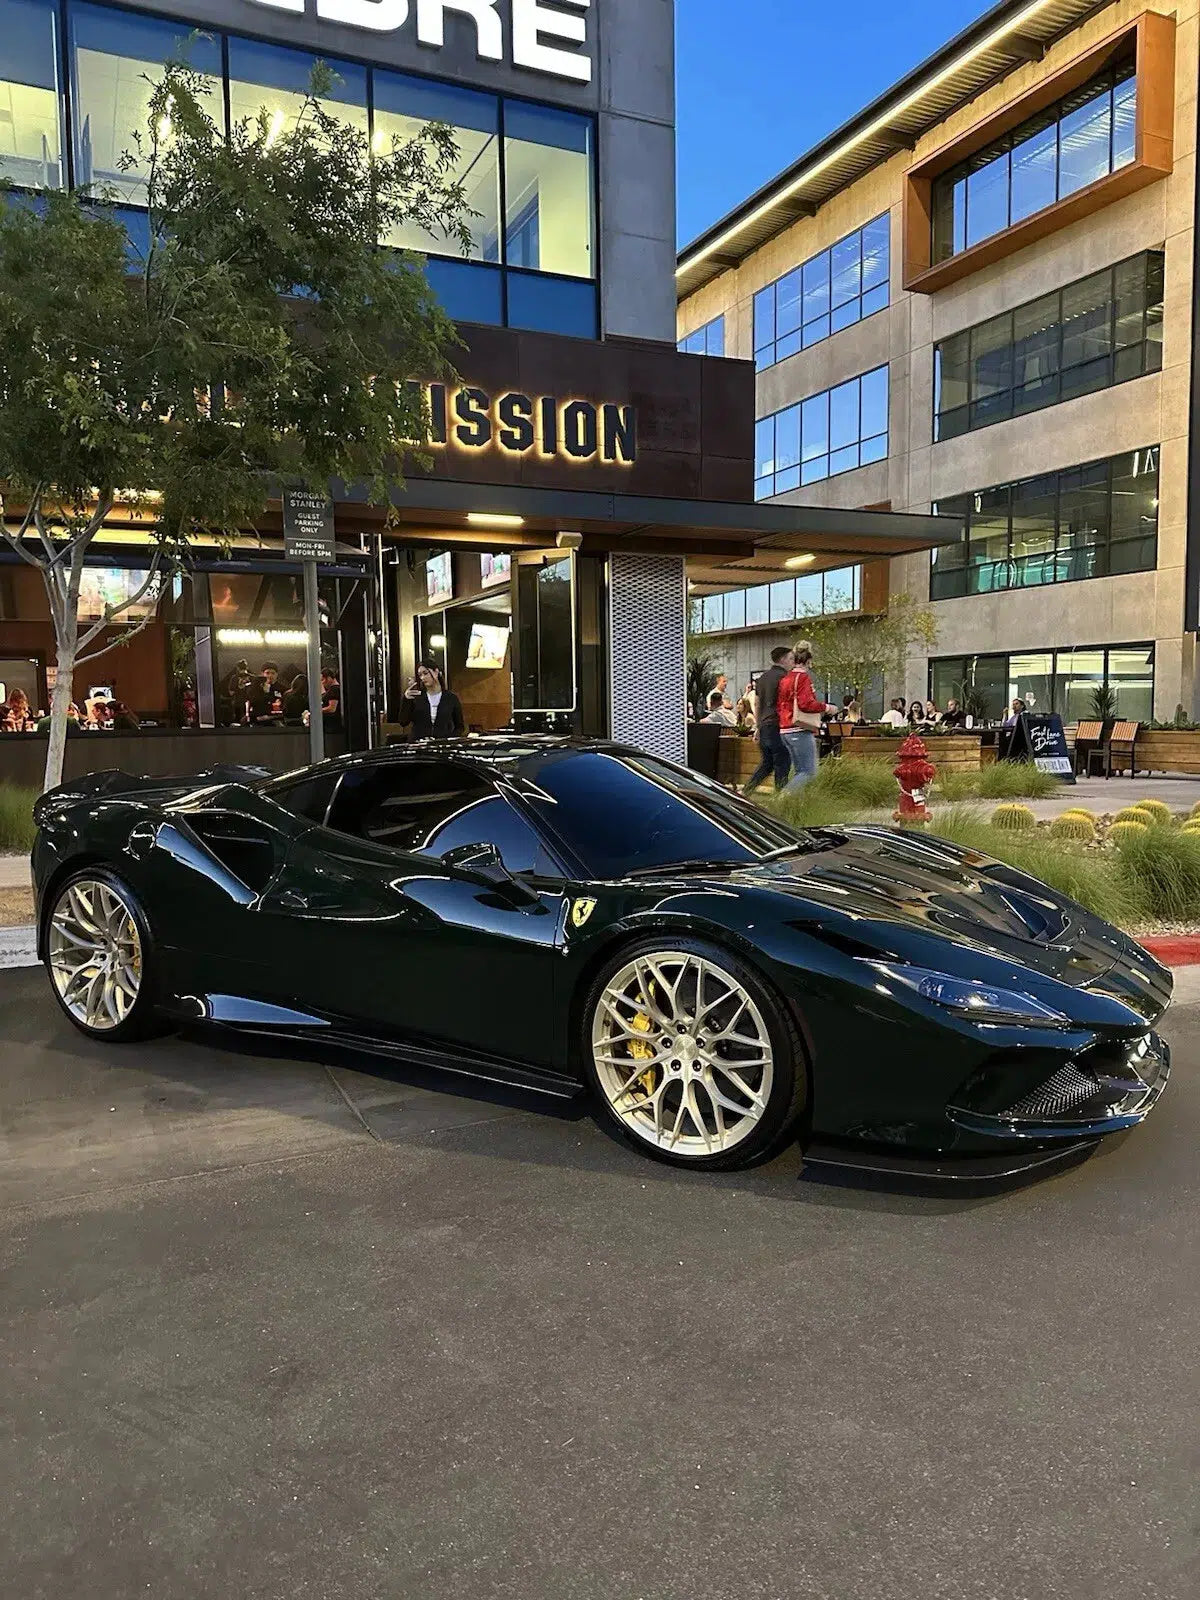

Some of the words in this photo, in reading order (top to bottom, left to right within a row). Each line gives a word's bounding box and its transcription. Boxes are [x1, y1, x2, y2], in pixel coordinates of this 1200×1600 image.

[290, 491, 326, 500] MORGAN
[290, 499, 326, 508] STANLEY
[1034, 737, 1059, 751] Drive
